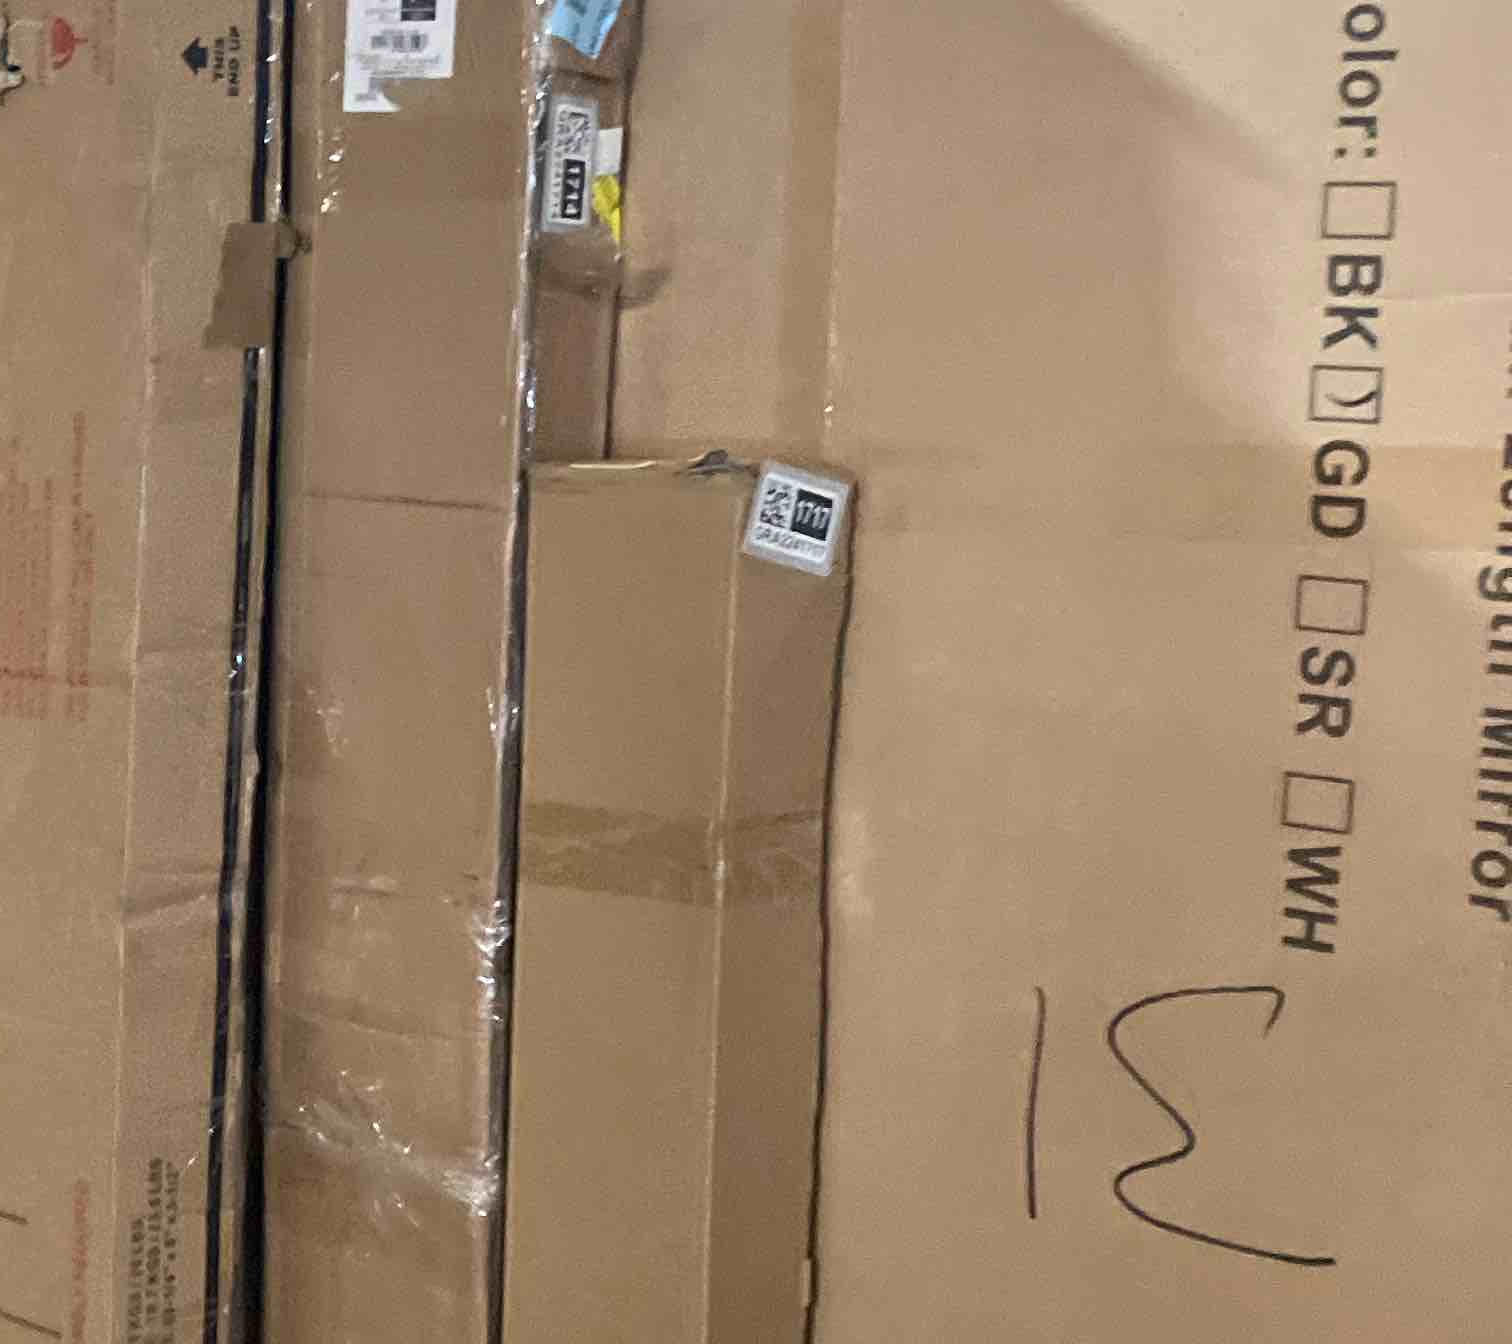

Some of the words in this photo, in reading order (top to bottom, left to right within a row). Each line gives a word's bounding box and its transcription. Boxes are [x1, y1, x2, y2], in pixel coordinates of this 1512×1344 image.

[1321, 254, 1384, 352] BK
[1308, 437, 1370, 540] GD
[1294, 645, 1357, 739] SR
[1280, 844, 1345, 954] WH
